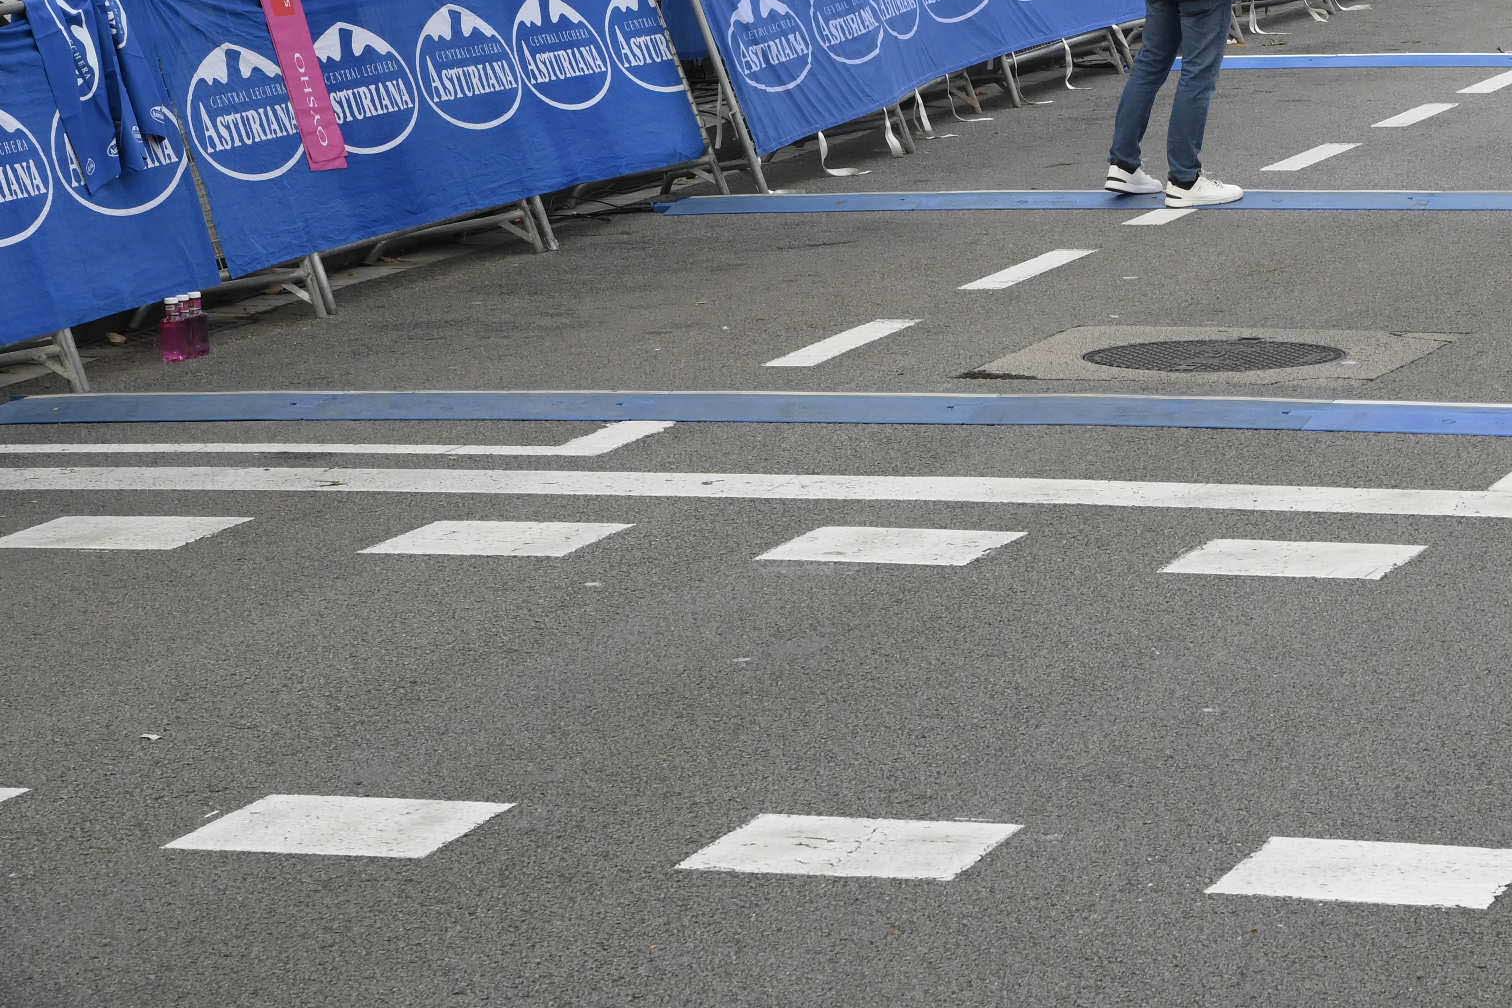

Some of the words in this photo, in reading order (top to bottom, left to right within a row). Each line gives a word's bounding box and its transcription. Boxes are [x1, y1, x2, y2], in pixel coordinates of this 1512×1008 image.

[436, 46, 470, 62] CENTRAL
[472, 42, 502, 58] LECHERA
[530, 32, 558, 47] CENTRAL
[559, 28, 590, 44] LECHERA
[362, 60, 398, 78] LECHERA
[426, 56, 518, 103] ASTURIANA
[522, 40, 606, 84] ASTURIANA
[210, 90, 250, 108] CENTRAL
[294, 52, 328, 146] OYSHO
[330, 78, 414, 125] STURIANA
[200, 100, 298, 154] ASTURIANA
